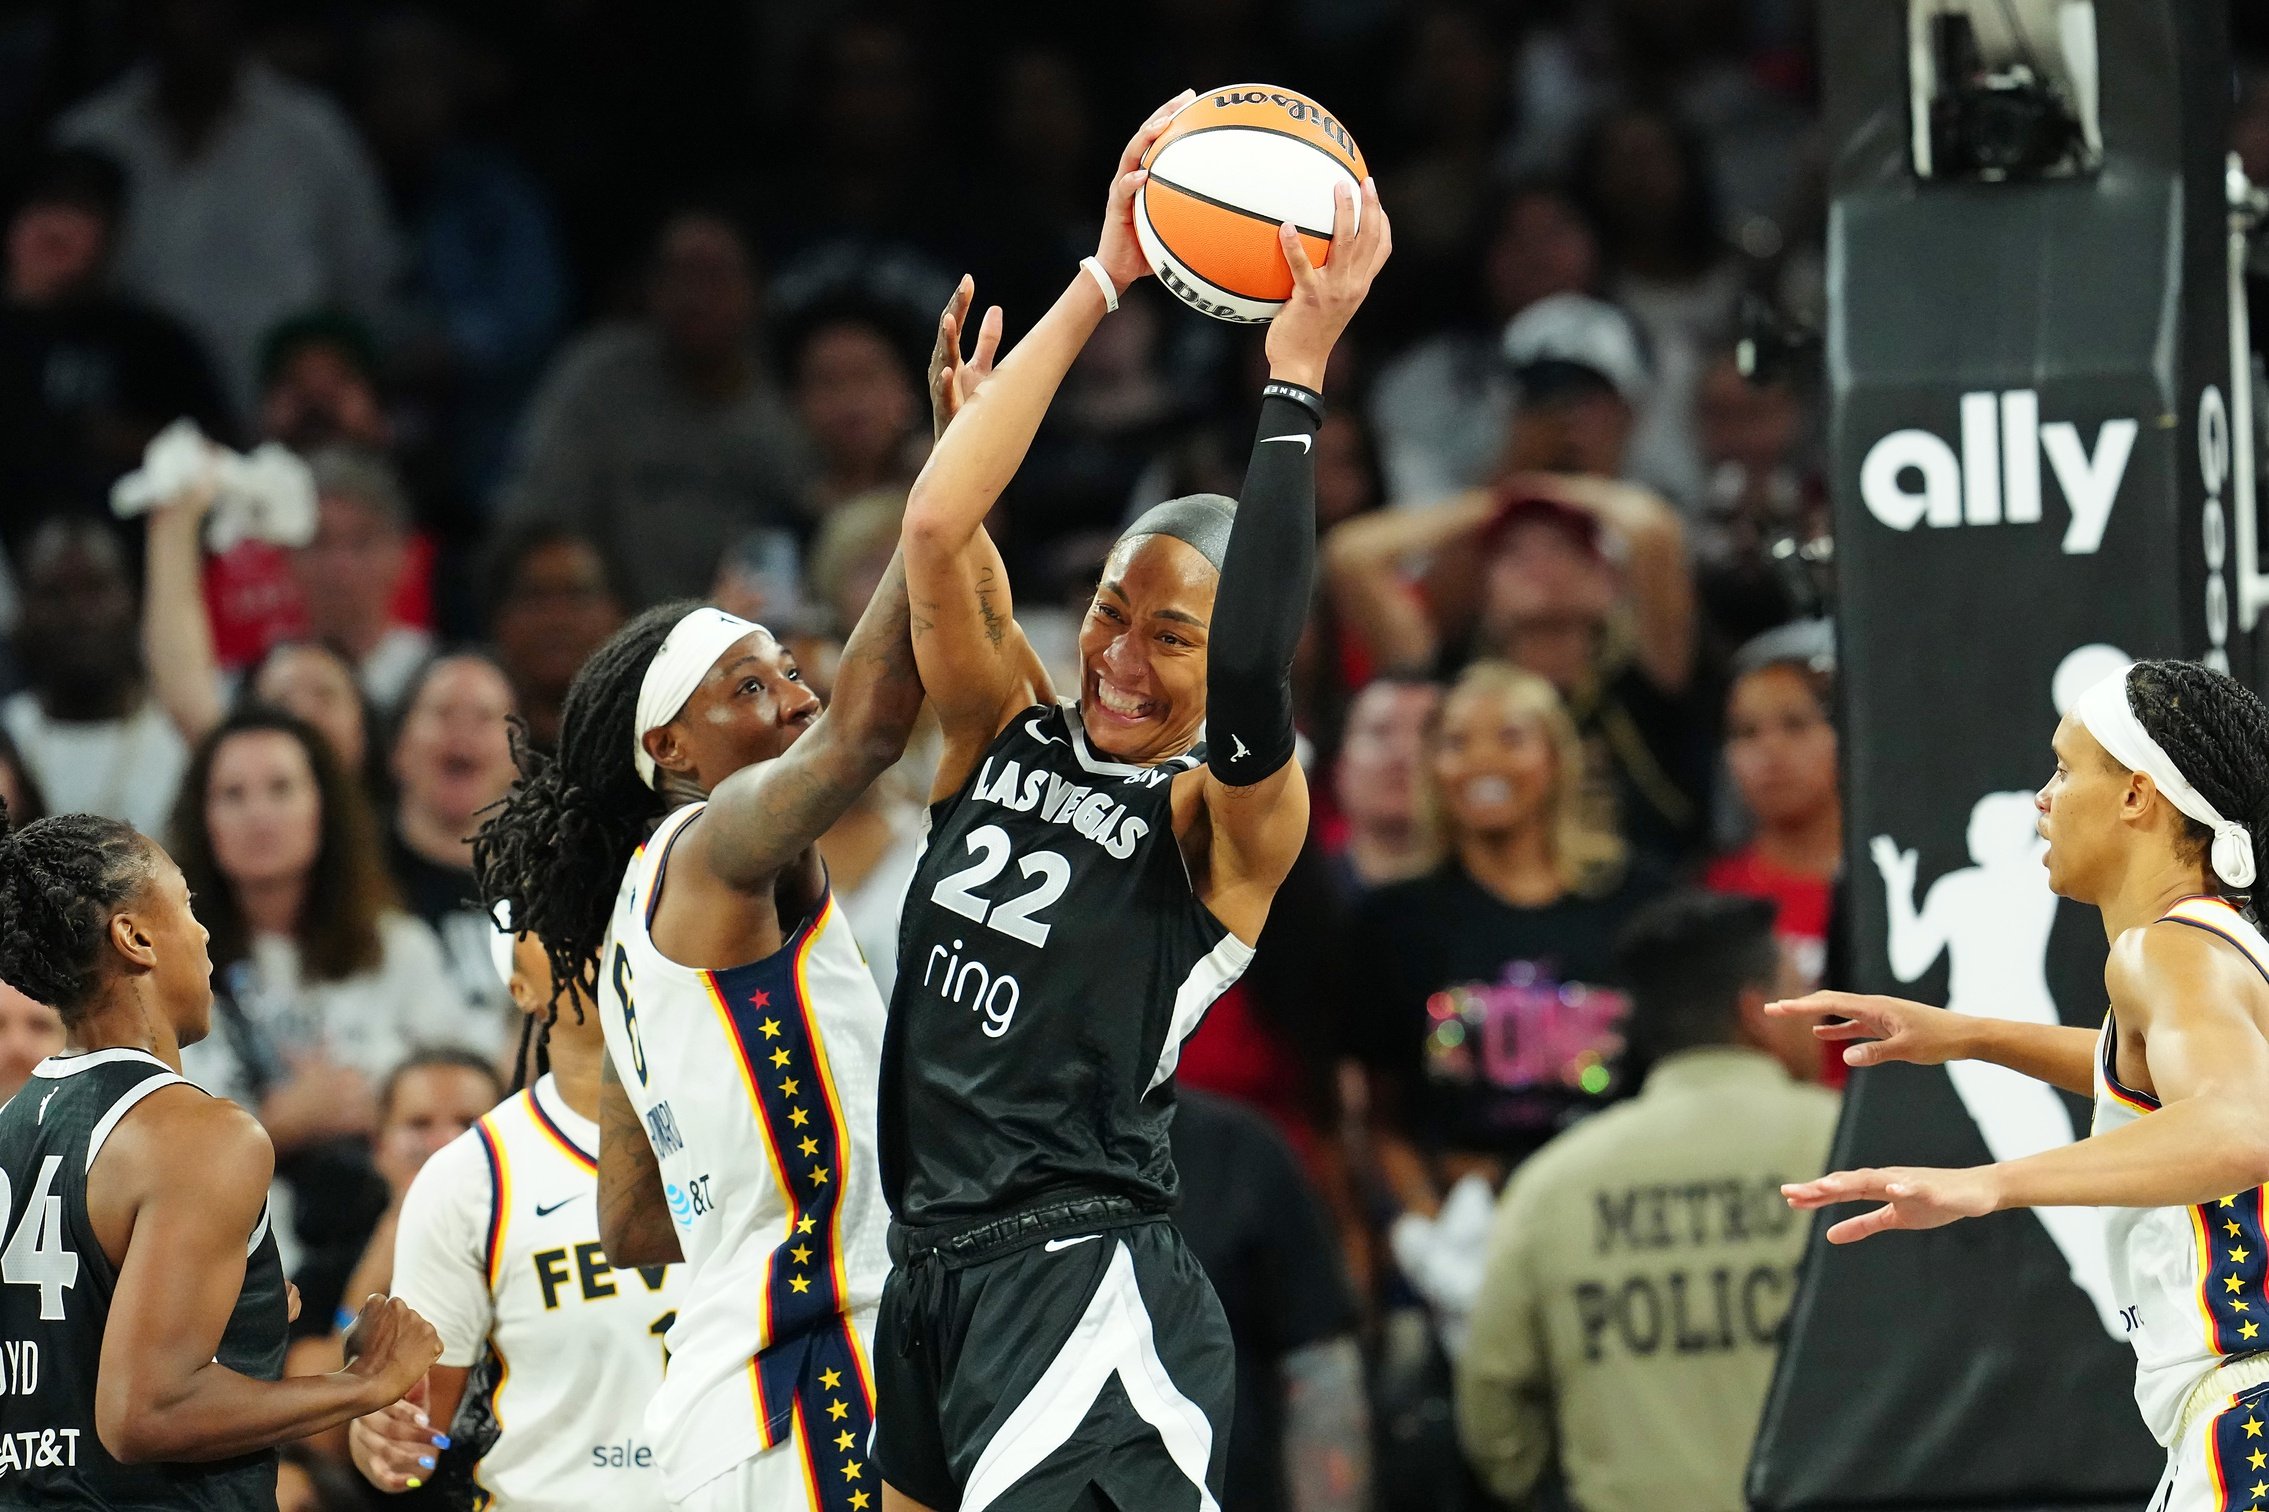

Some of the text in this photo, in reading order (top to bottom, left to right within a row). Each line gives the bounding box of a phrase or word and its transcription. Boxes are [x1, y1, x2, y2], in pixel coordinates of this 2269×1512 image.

[1214, 91, 1356, 162] Wilson
[1860, 388, 2138, 555] ally
[930, 823, 1072, 949] 22
[612, 938, 649, 1088] 6
[923, 939, 1020, 1038] ring
[0, 1154, 79, 1321] 4
[1594, 1173, 1795, 1256] METRO
[1572, 1263, 1802, 1364] POLIC
[0, 1428, 80, 1471] AT&T
[592, 1438, 653, 1469] sale
